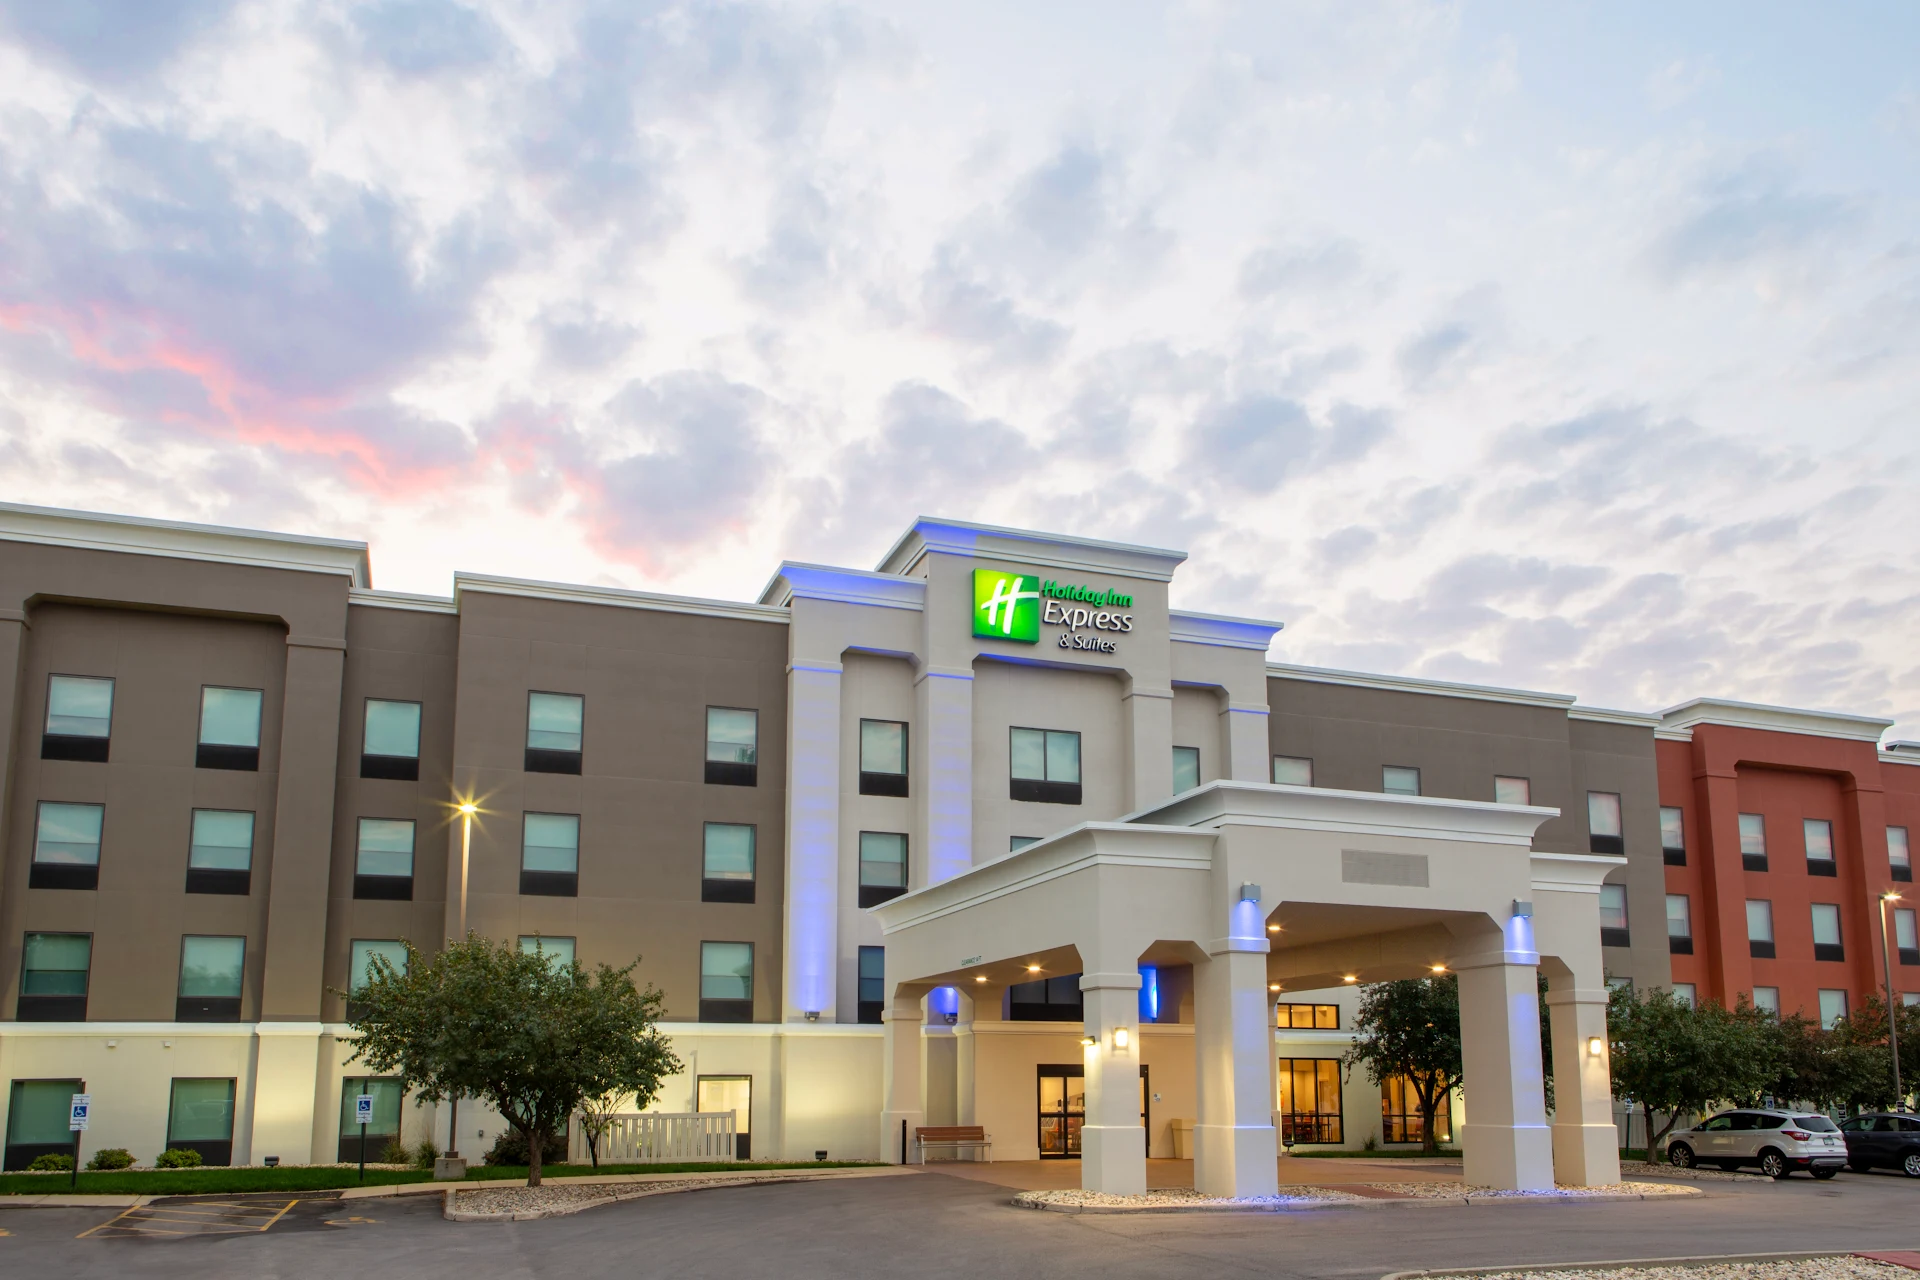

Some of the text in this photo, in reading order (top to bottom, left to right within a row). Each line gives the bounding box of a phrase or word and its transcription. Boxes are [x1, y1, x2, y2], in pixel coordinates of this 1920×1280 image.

[1042, 579, 1134, 608] Holiday Inn
[1043, 599, 1134, 633] Express
[1059, 632, 1117, 654] & Suites
